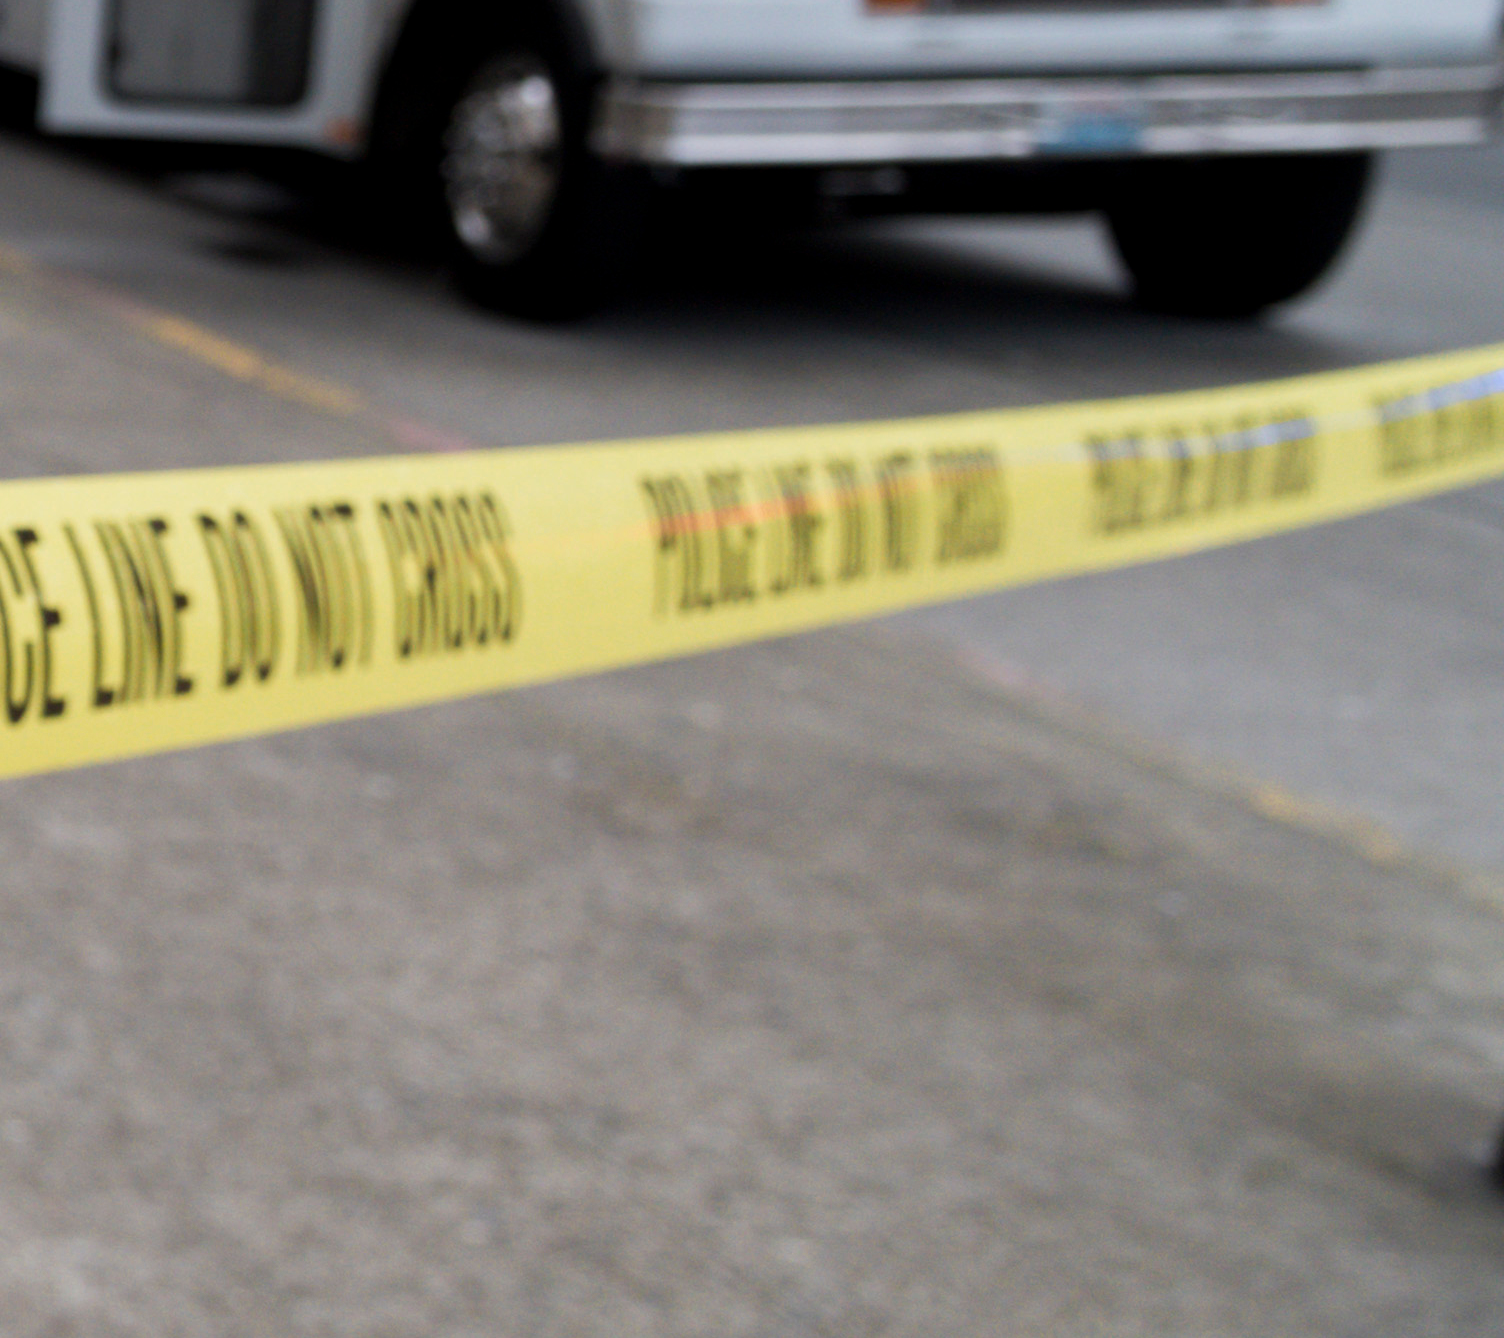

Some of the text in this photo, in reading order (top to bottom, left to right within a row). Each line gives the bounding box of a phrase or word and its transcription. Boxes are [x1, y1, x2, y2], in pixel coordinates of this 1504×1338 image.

[61, 517, 193, 708] LINE
[197, 511, 282, 689] DO
[270, 501, 375, 676] NOT
